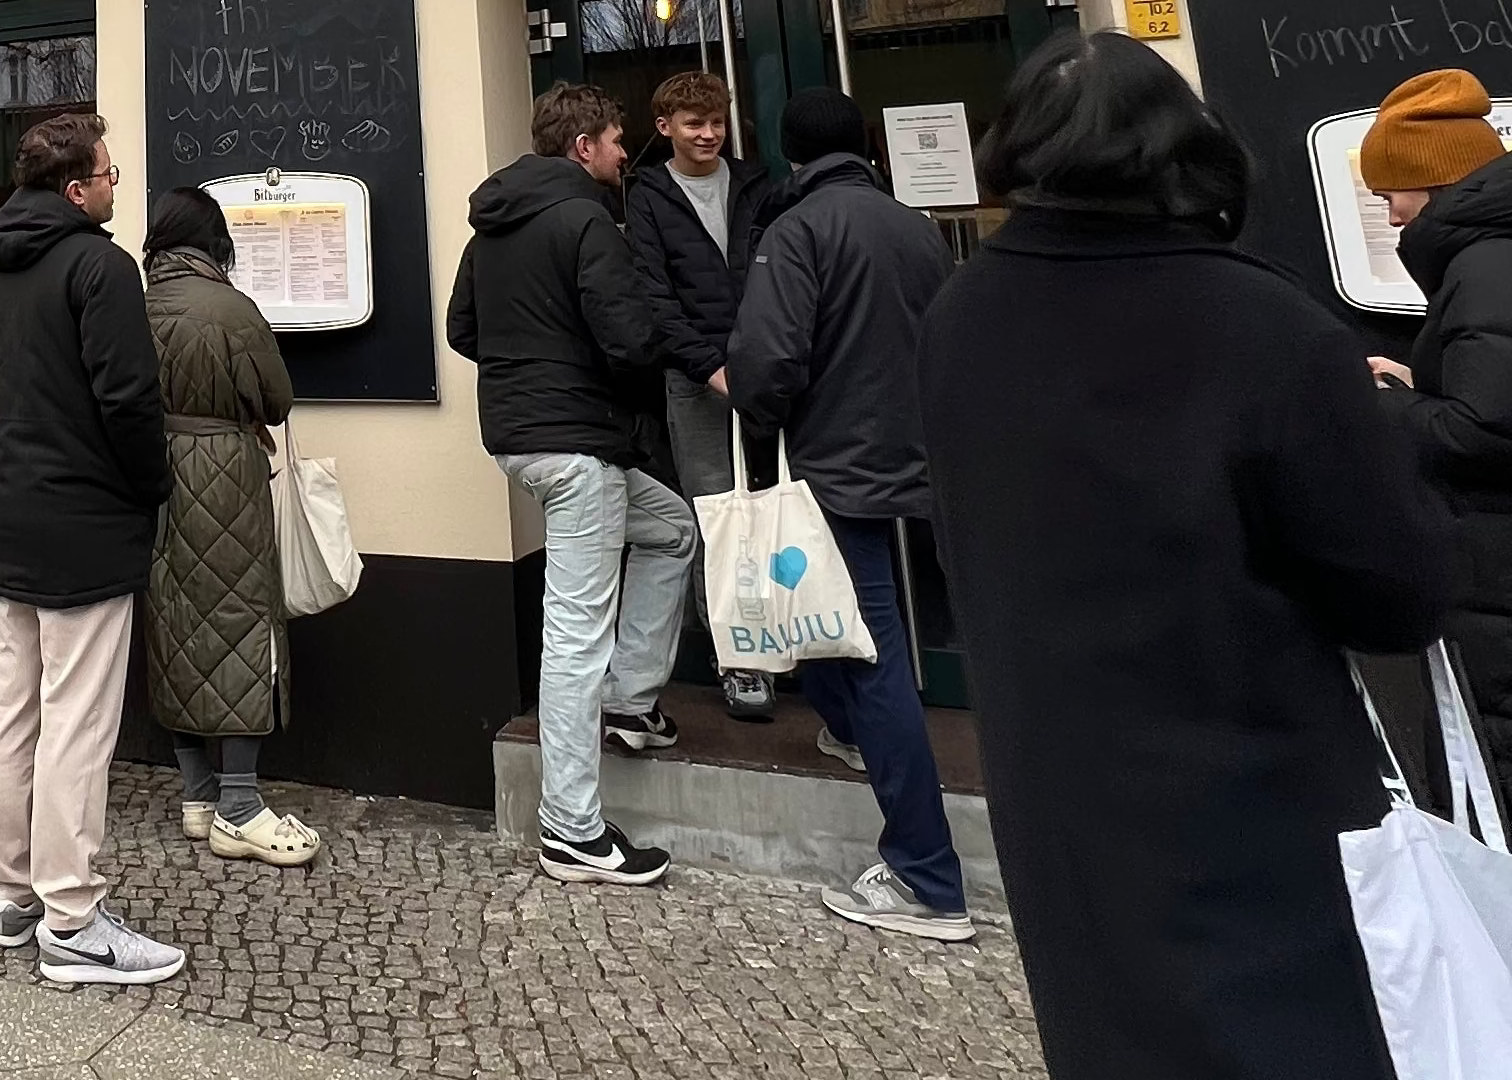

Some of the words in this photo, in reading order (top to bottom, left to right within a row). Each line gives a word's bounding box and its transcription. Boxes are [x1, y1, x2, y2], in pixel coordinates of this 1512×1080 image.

[170, 38, 406, 100] NOVEMBER
[1261, 4, 1429, 78] Kommt
[254, 188, 296, 202] Bitburger
